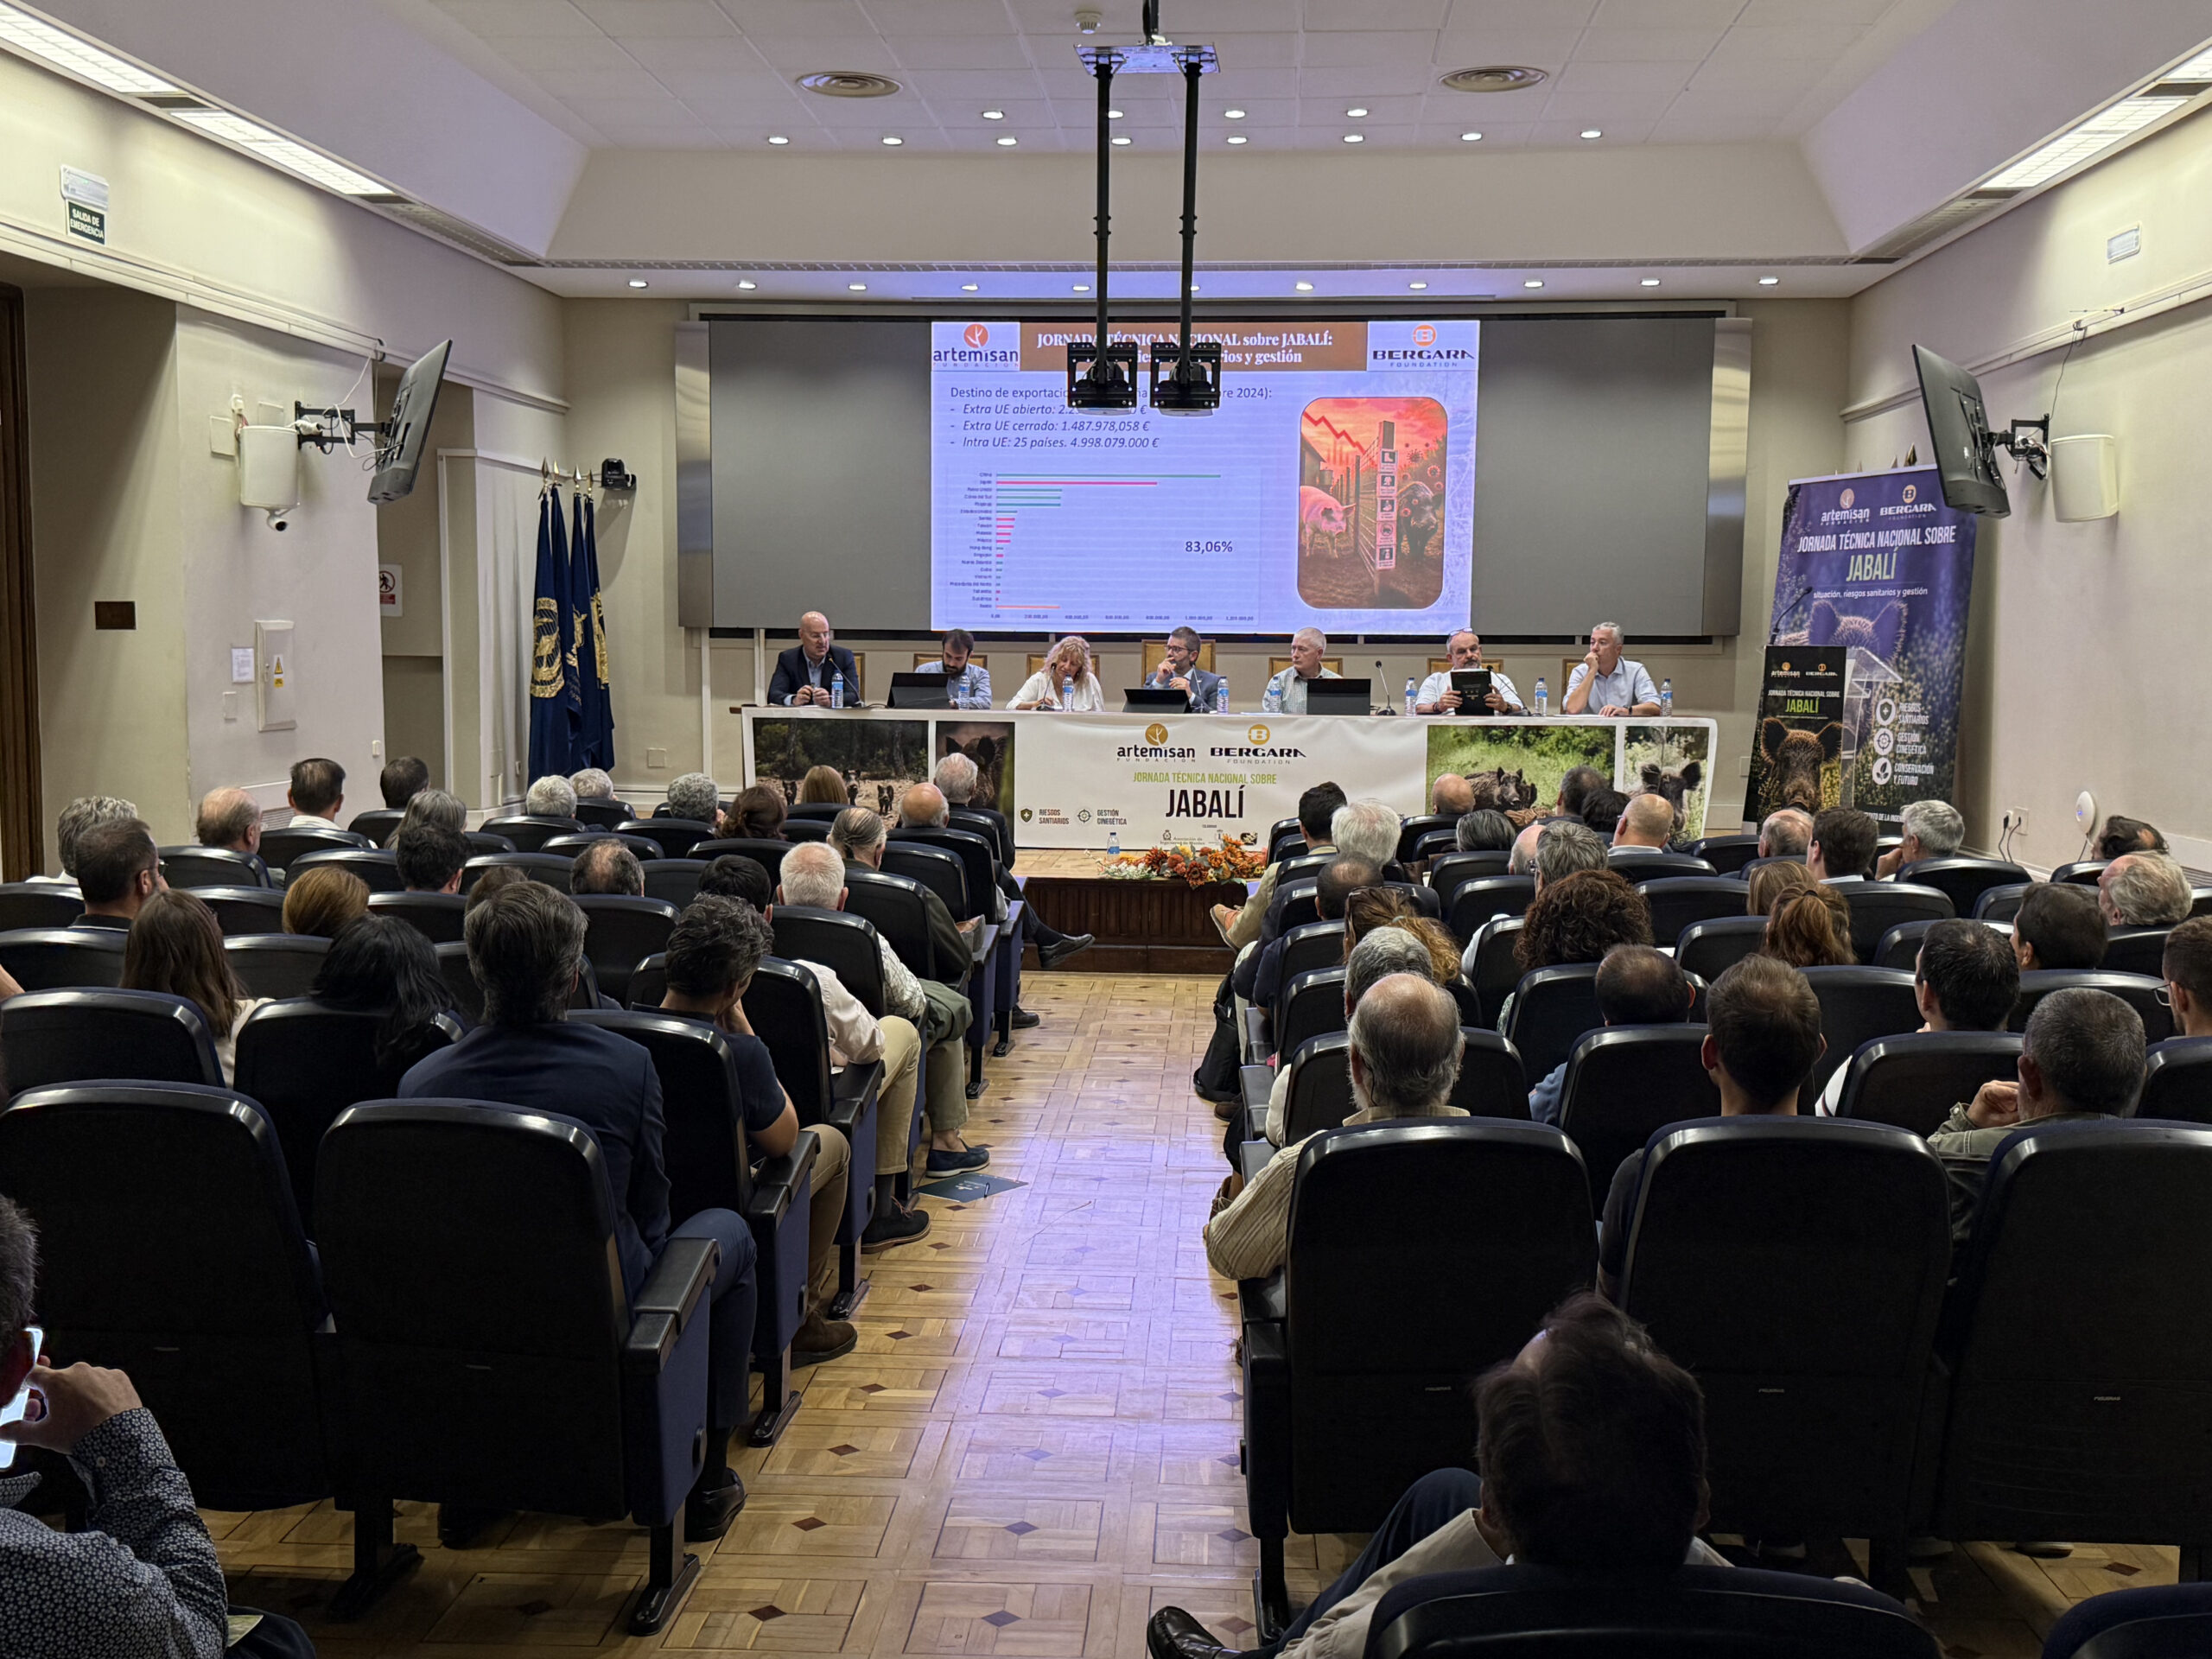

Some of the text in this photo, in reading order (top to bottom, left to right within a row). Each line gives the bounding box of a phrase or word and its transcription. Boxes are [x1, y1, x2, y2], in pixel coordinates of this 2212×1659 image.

[73, 208, 99, 226] SALIDA DE
[70, 219, 104, 238] EMERGENCIA
[1037, 334, 1097, 348] JORNAD
[1168, 334, 1241, 346] NCIONAL
[1243, 332, 1279, 346] sobre
[1281, 330, 1332, 347] JABALÍ:
[933, 347, 1018, 362] artemisan
[1244, 353, 1253, 365] y
[1255, 349, 1302, 365] gestión
[1372, 350, 1475, 359] BERGARA
[950, 387, 992, 397] Destino
[995, 387, 1008, 397] de
[1236, 387, 1272, 400] 2024):
[963, 404, 991, 414] Extra
[995, 404, 1009, 414] UE
[1013, 404, 1056, 414] abierto:
[963, 420, 991, 430] Extra
[995, 421, 1009, 430] UE
[1013, 420, 1058, 430] cerrado:
[1142, 421, 1150, 431] €
[963, 436, 1160, 449] Intra UE: 25 países. 4.998.079.000 €
[1821, 508, 1870, 522] artemisan
[1880, 503, 1936, 516] BERGARA
[1797, 525, 1956, 553] JORNADA TÉCNICA NACIONAL SOBRE
[1185, 541, 1233, 554] 83,06%
[1846, 547, 1899, 582] JABALÍ
[1843, 589, 1866, 599] riesgos
[1866, 588, 1896, 597] sanitarios
[1902, 587, 1928, 597] gestión
[1785, 697, 1820, 713] JABALÍ
[1117, 744, 1195, 758] artemisan
[1211, 747, 1306, 758] BERGARA
[1134, 771, 1277, 785] JORNADA TÉCNICA NACIONAL SOBRE
[1166, 785, 1245, 818] JABALÍ
